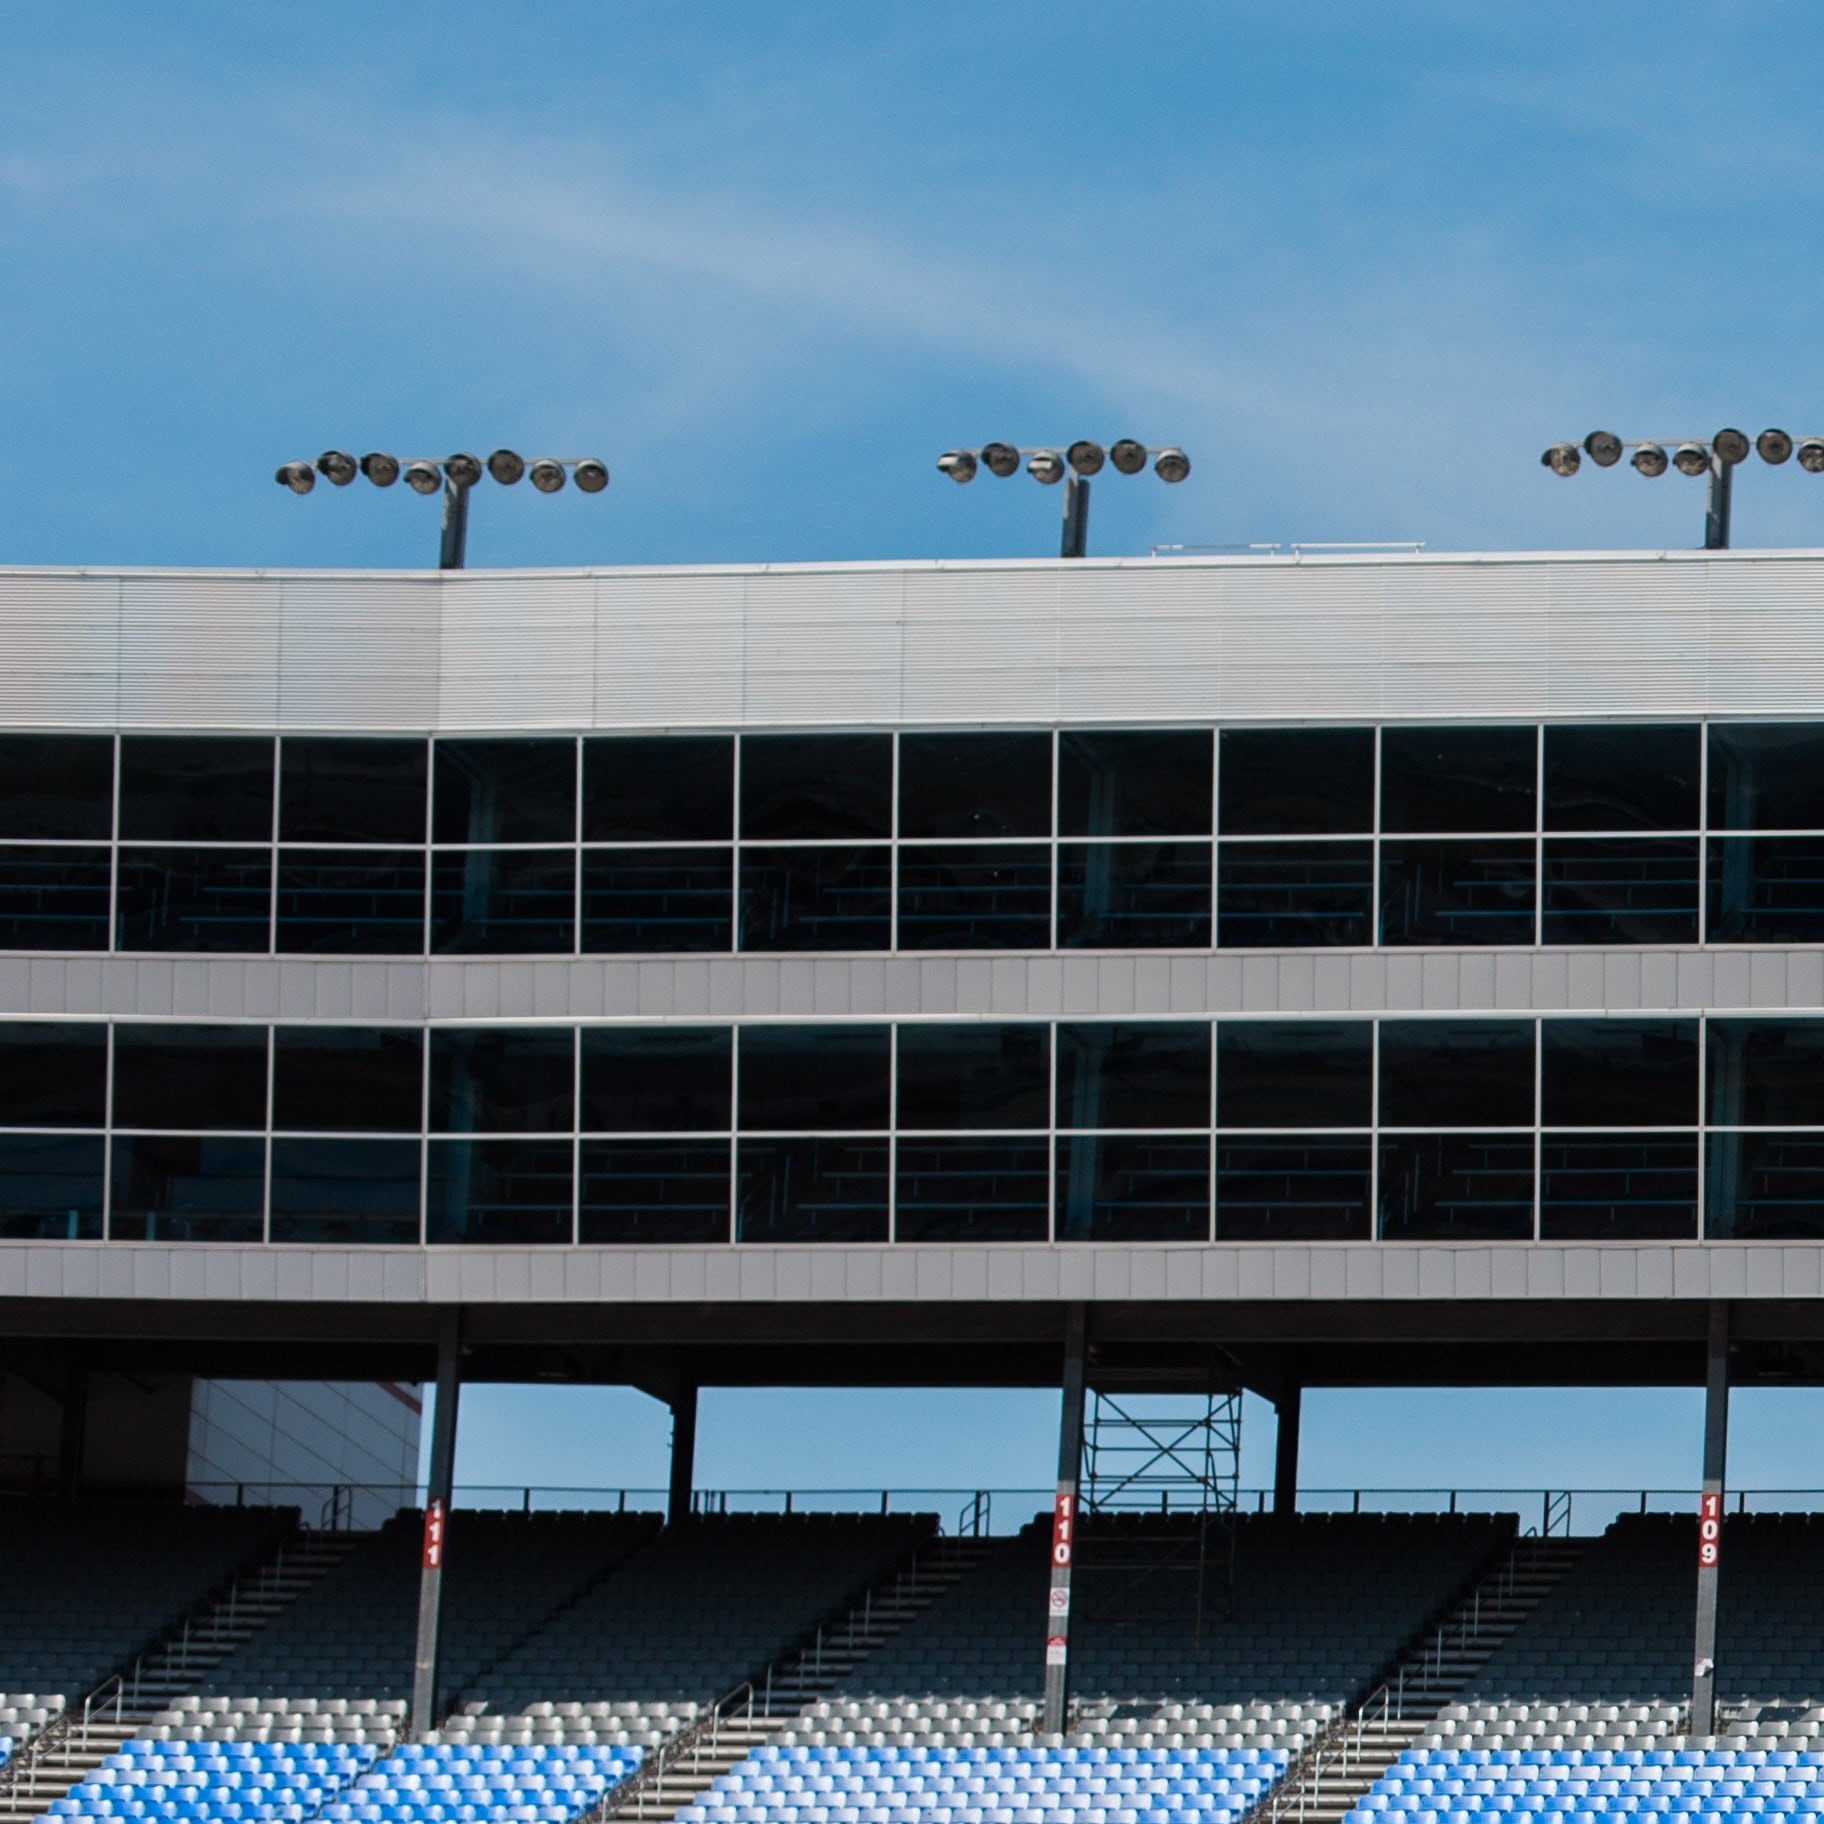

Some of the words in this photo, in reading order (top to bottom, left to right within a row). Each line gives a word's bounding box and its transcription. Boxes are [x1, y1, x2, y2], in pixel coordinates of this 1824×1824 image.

[427, 1496, 442, 1566] 111
[1054, 1496, 1071, 1565] 110
[1701, 1496, 1718, 1565] 109
